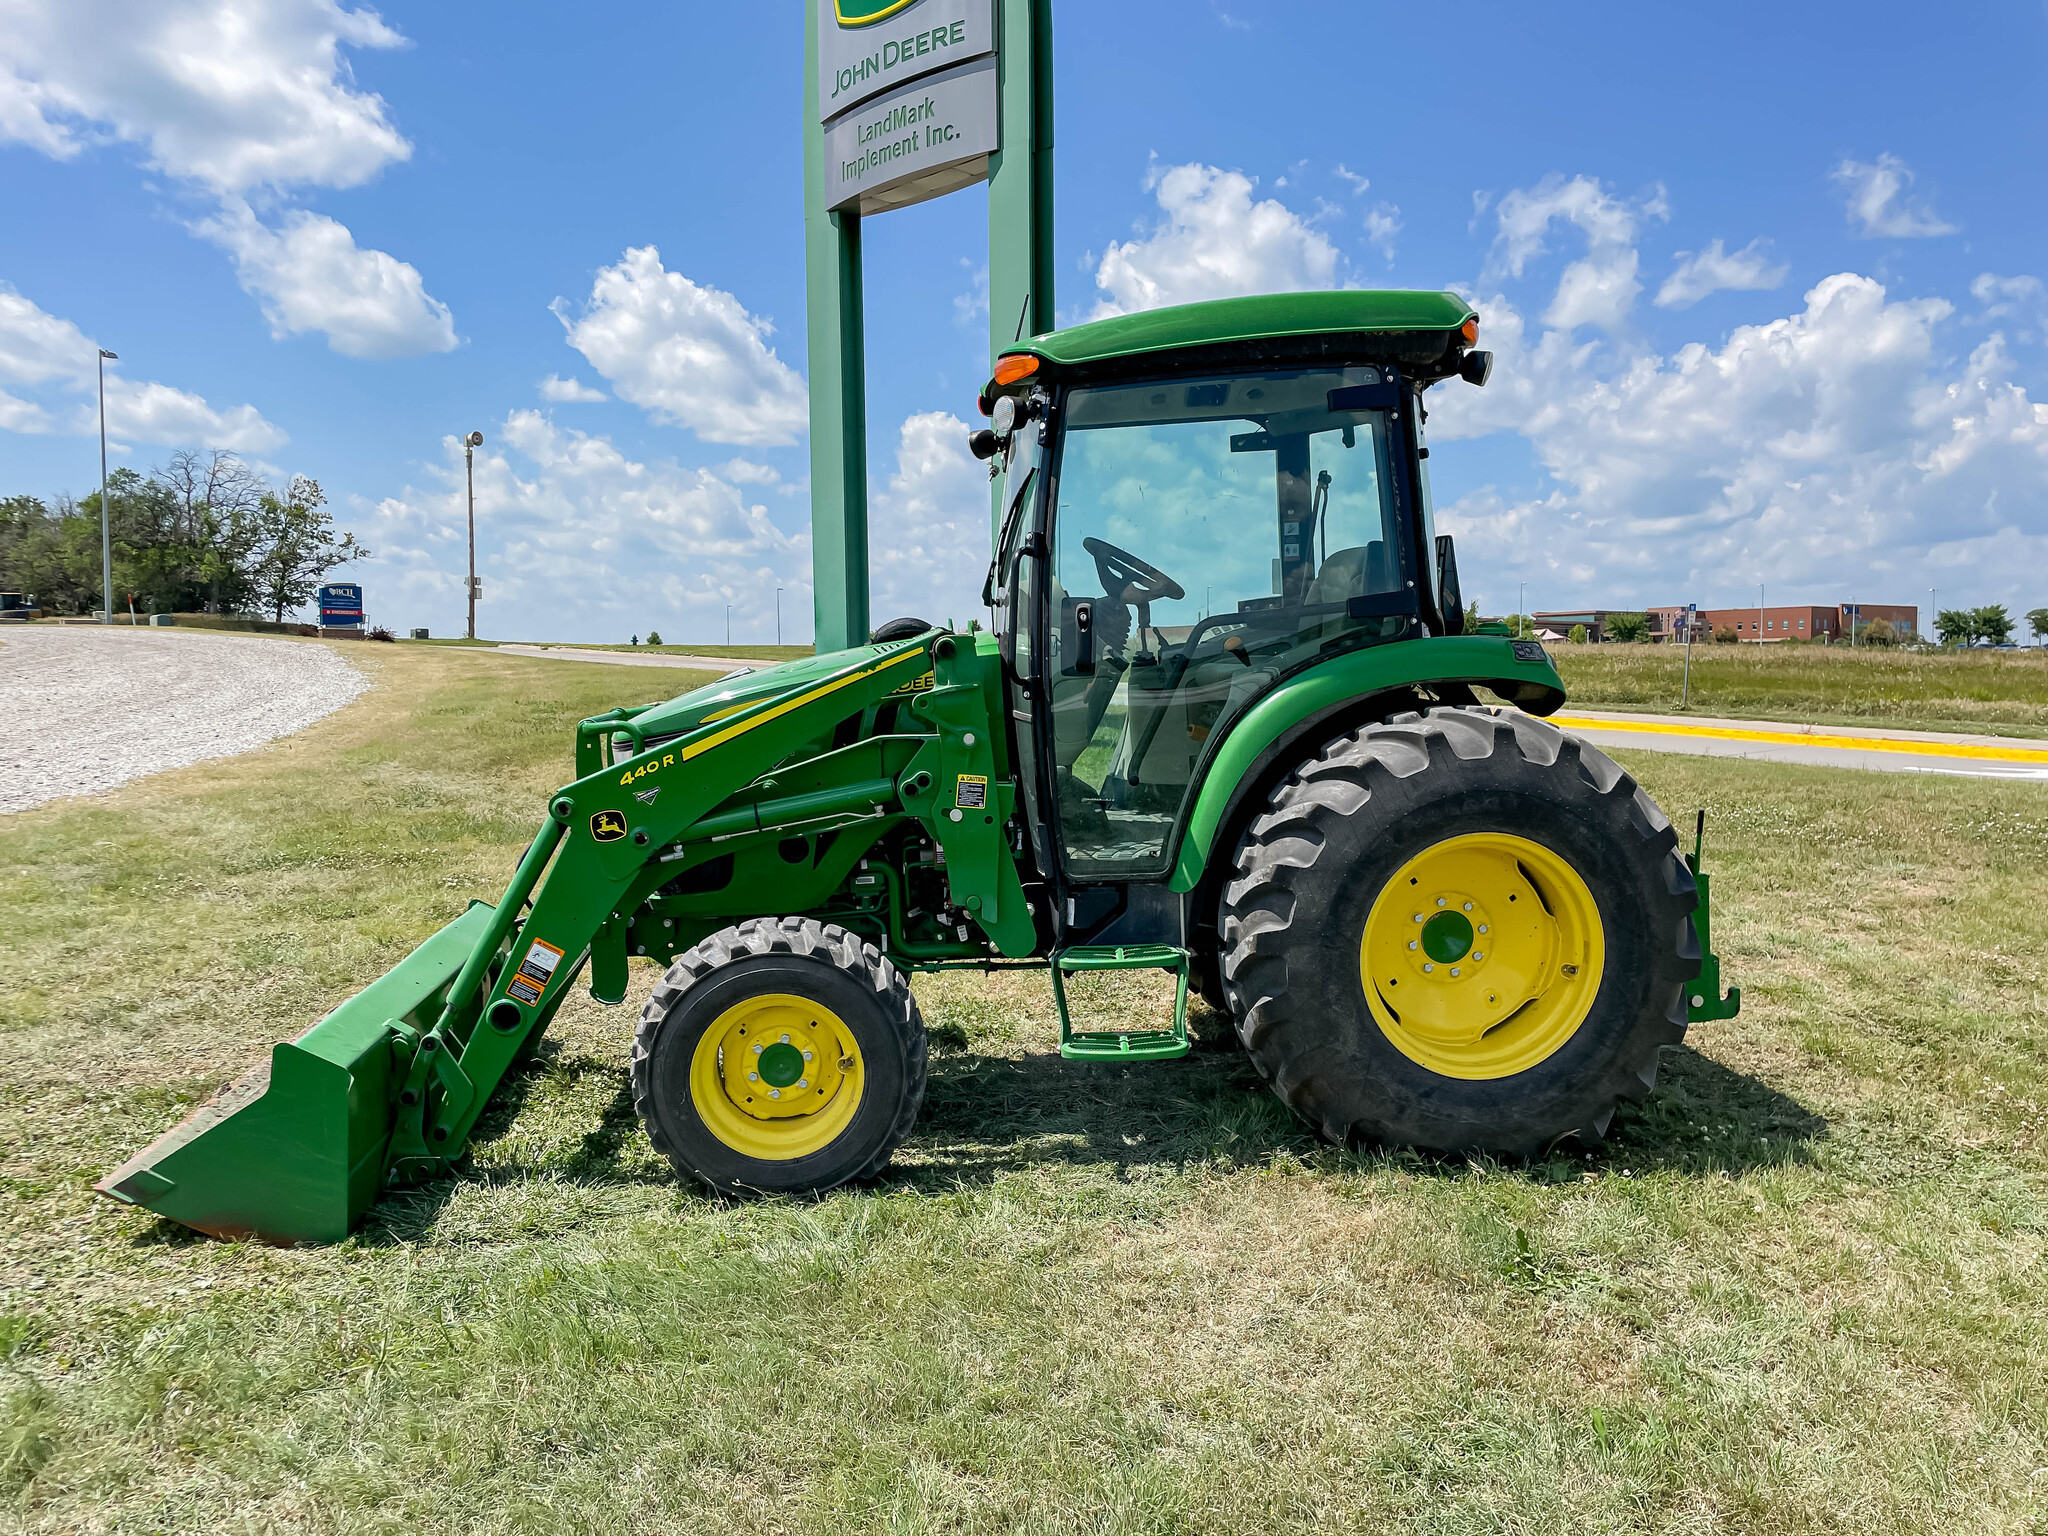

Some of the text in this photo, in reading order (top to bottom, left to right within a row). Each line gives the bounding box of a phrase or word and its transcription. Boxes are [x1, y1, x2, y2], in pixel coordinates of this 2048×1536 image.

[831, 19, 965, 99] JOHN DEERE
[857, 96, 936, 147] LandMark
[841, 123, 961, 183] Implement Inc.
